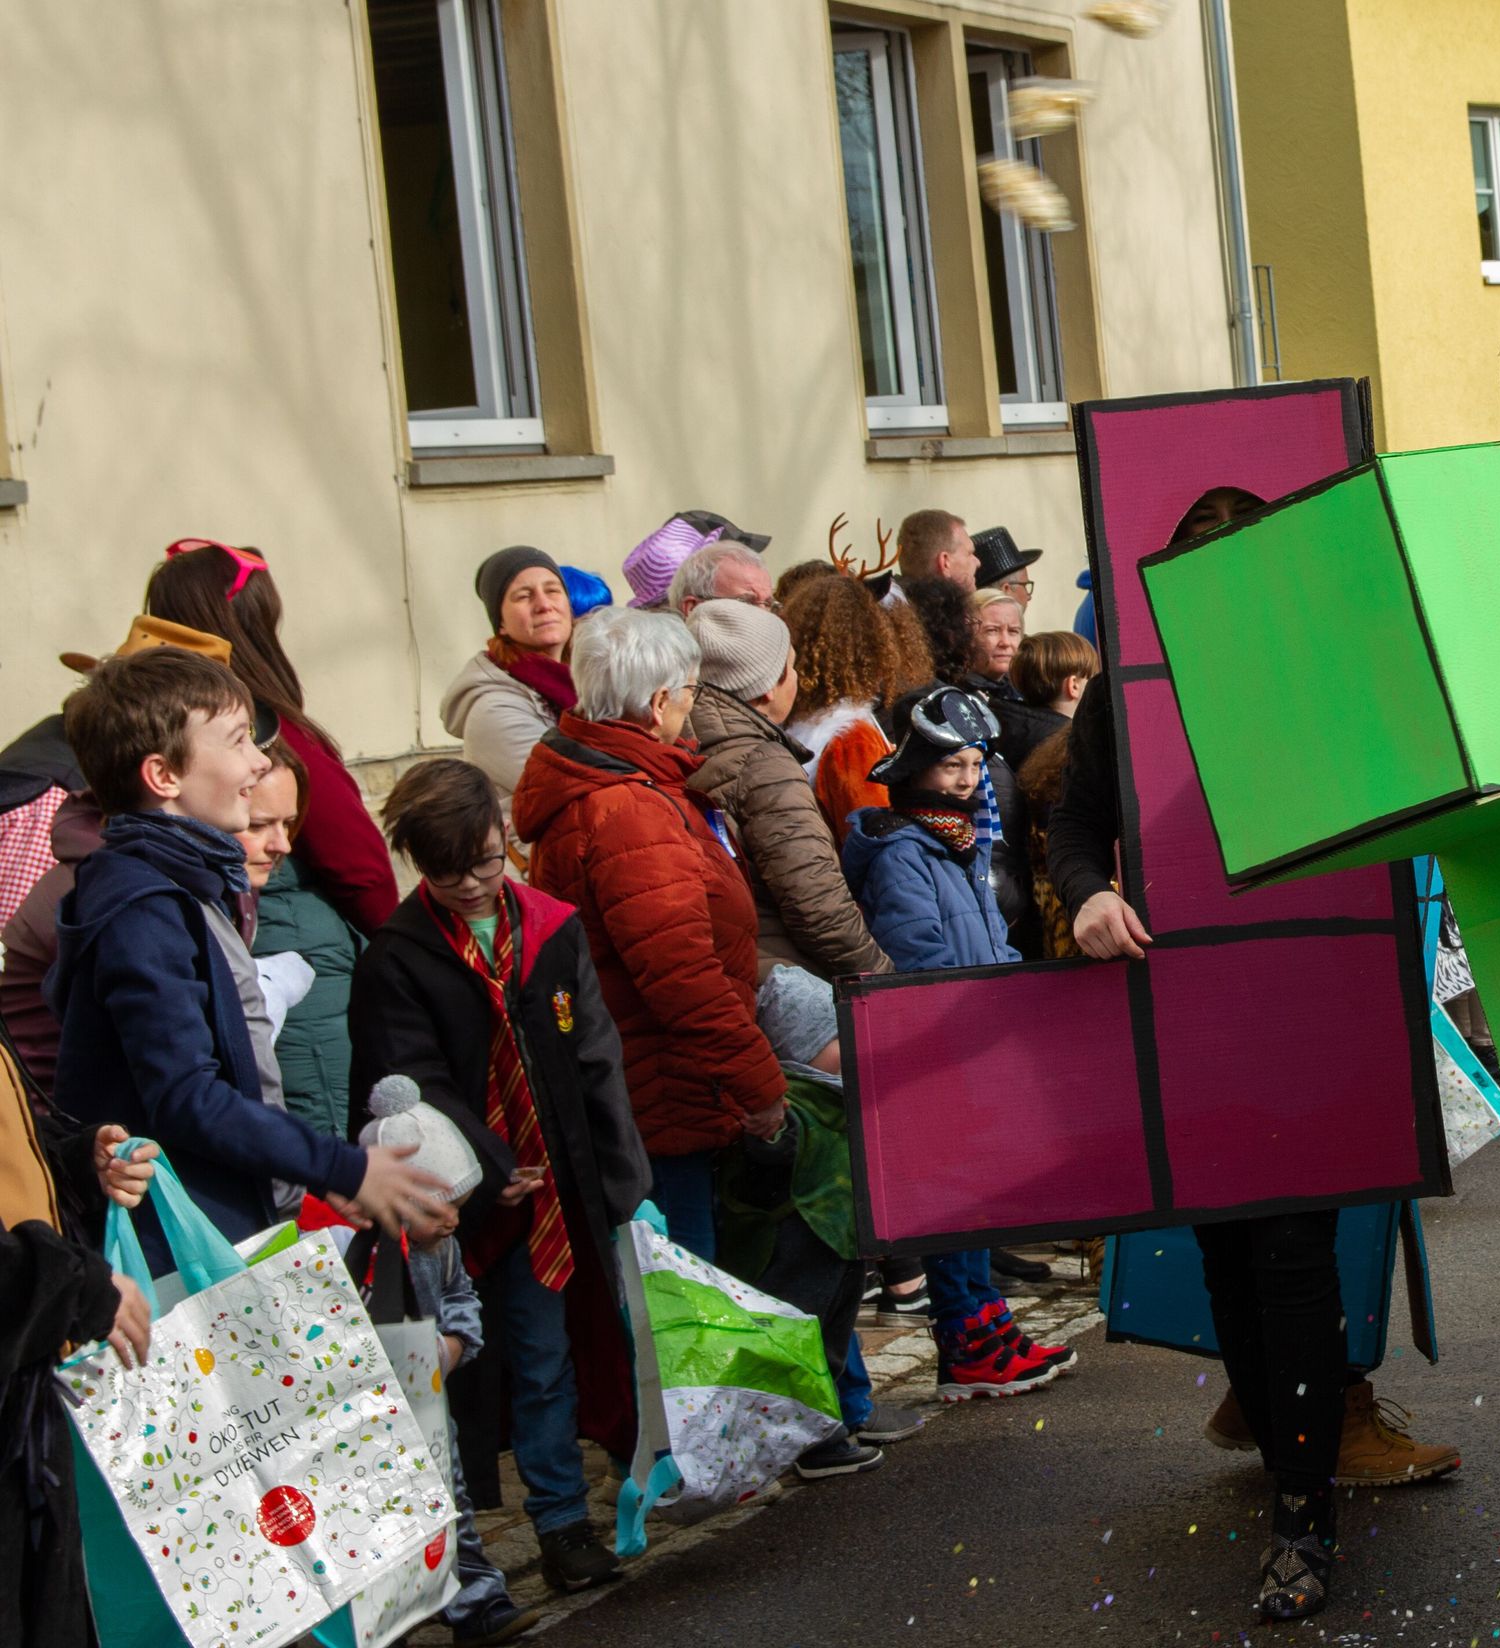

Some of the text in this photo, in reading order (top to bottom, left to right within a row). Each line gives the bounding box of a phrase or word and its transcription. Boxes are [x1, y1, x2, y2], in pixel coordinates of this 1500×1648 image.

[209, 1398, 280, 1454] ÖKO-TUT
[244, 1431, 263, 1447] FIR
[213, 1426, 300, 1487] D'LIEWEN
